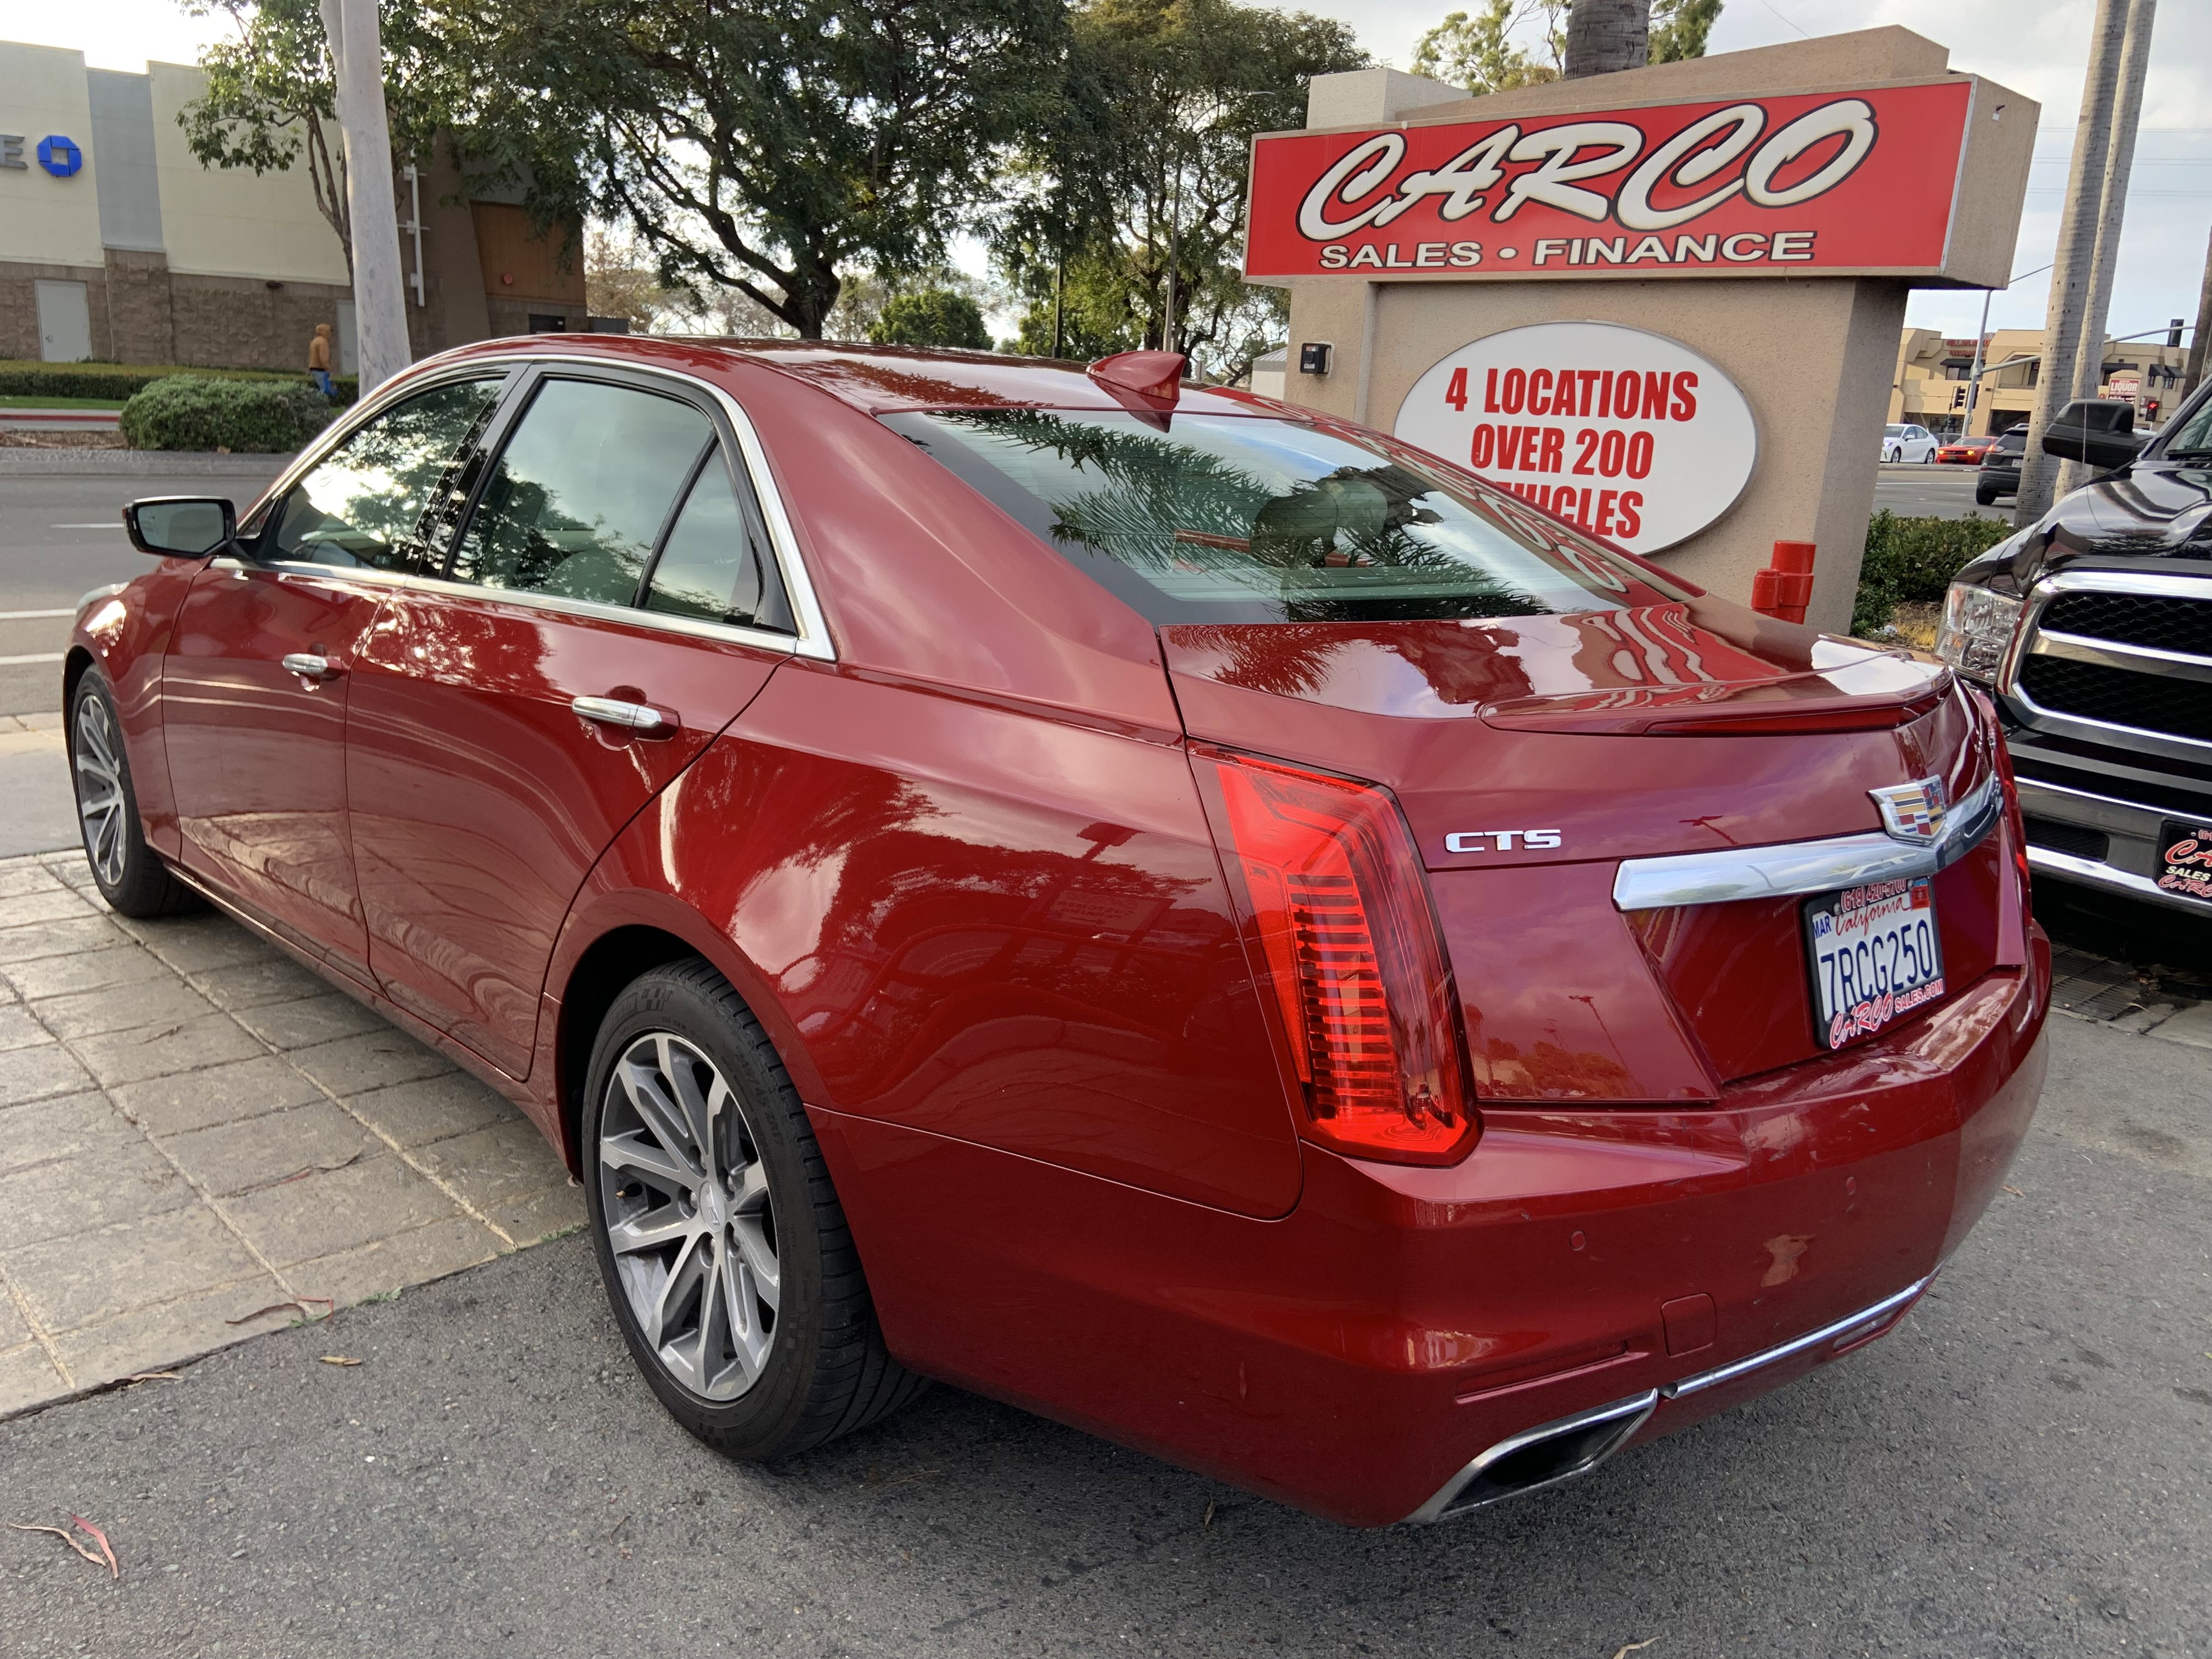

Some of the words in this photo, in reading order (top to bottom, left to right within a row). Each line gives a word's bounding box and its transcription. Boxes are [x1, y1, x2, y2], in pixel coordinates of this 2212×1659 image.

[1298, 98, 1878, 242] CARCO
[1319, 240, 1482, 269] SALES
[1532, 230, 1818, 266] FINANCE
[1444, 367, 1469, 413] 4
[1485, 366, 1699, 422] LOCATIONS
[2111, 382, 2138, 392] LIQUOR
[1471, 423, 1565, 475] OVER
[1571, 428, 1654, 481] 200
[1445, 830, 1561, 853] CTS
[2165, 866, 2211, 882] SALES
[1841, 885, 1865, 913] (619)
[1865, 879, 1907, 904] 420-5700
[1813, 915, 1831, 939] MAR
[1835, 896, 1911, 936] California
[1820, 919, 1933, 1017] 7RCG250
[1830, 992, 1893, 1049] CARCO
[1894, 979, 1944, 1014] SALES.COM
